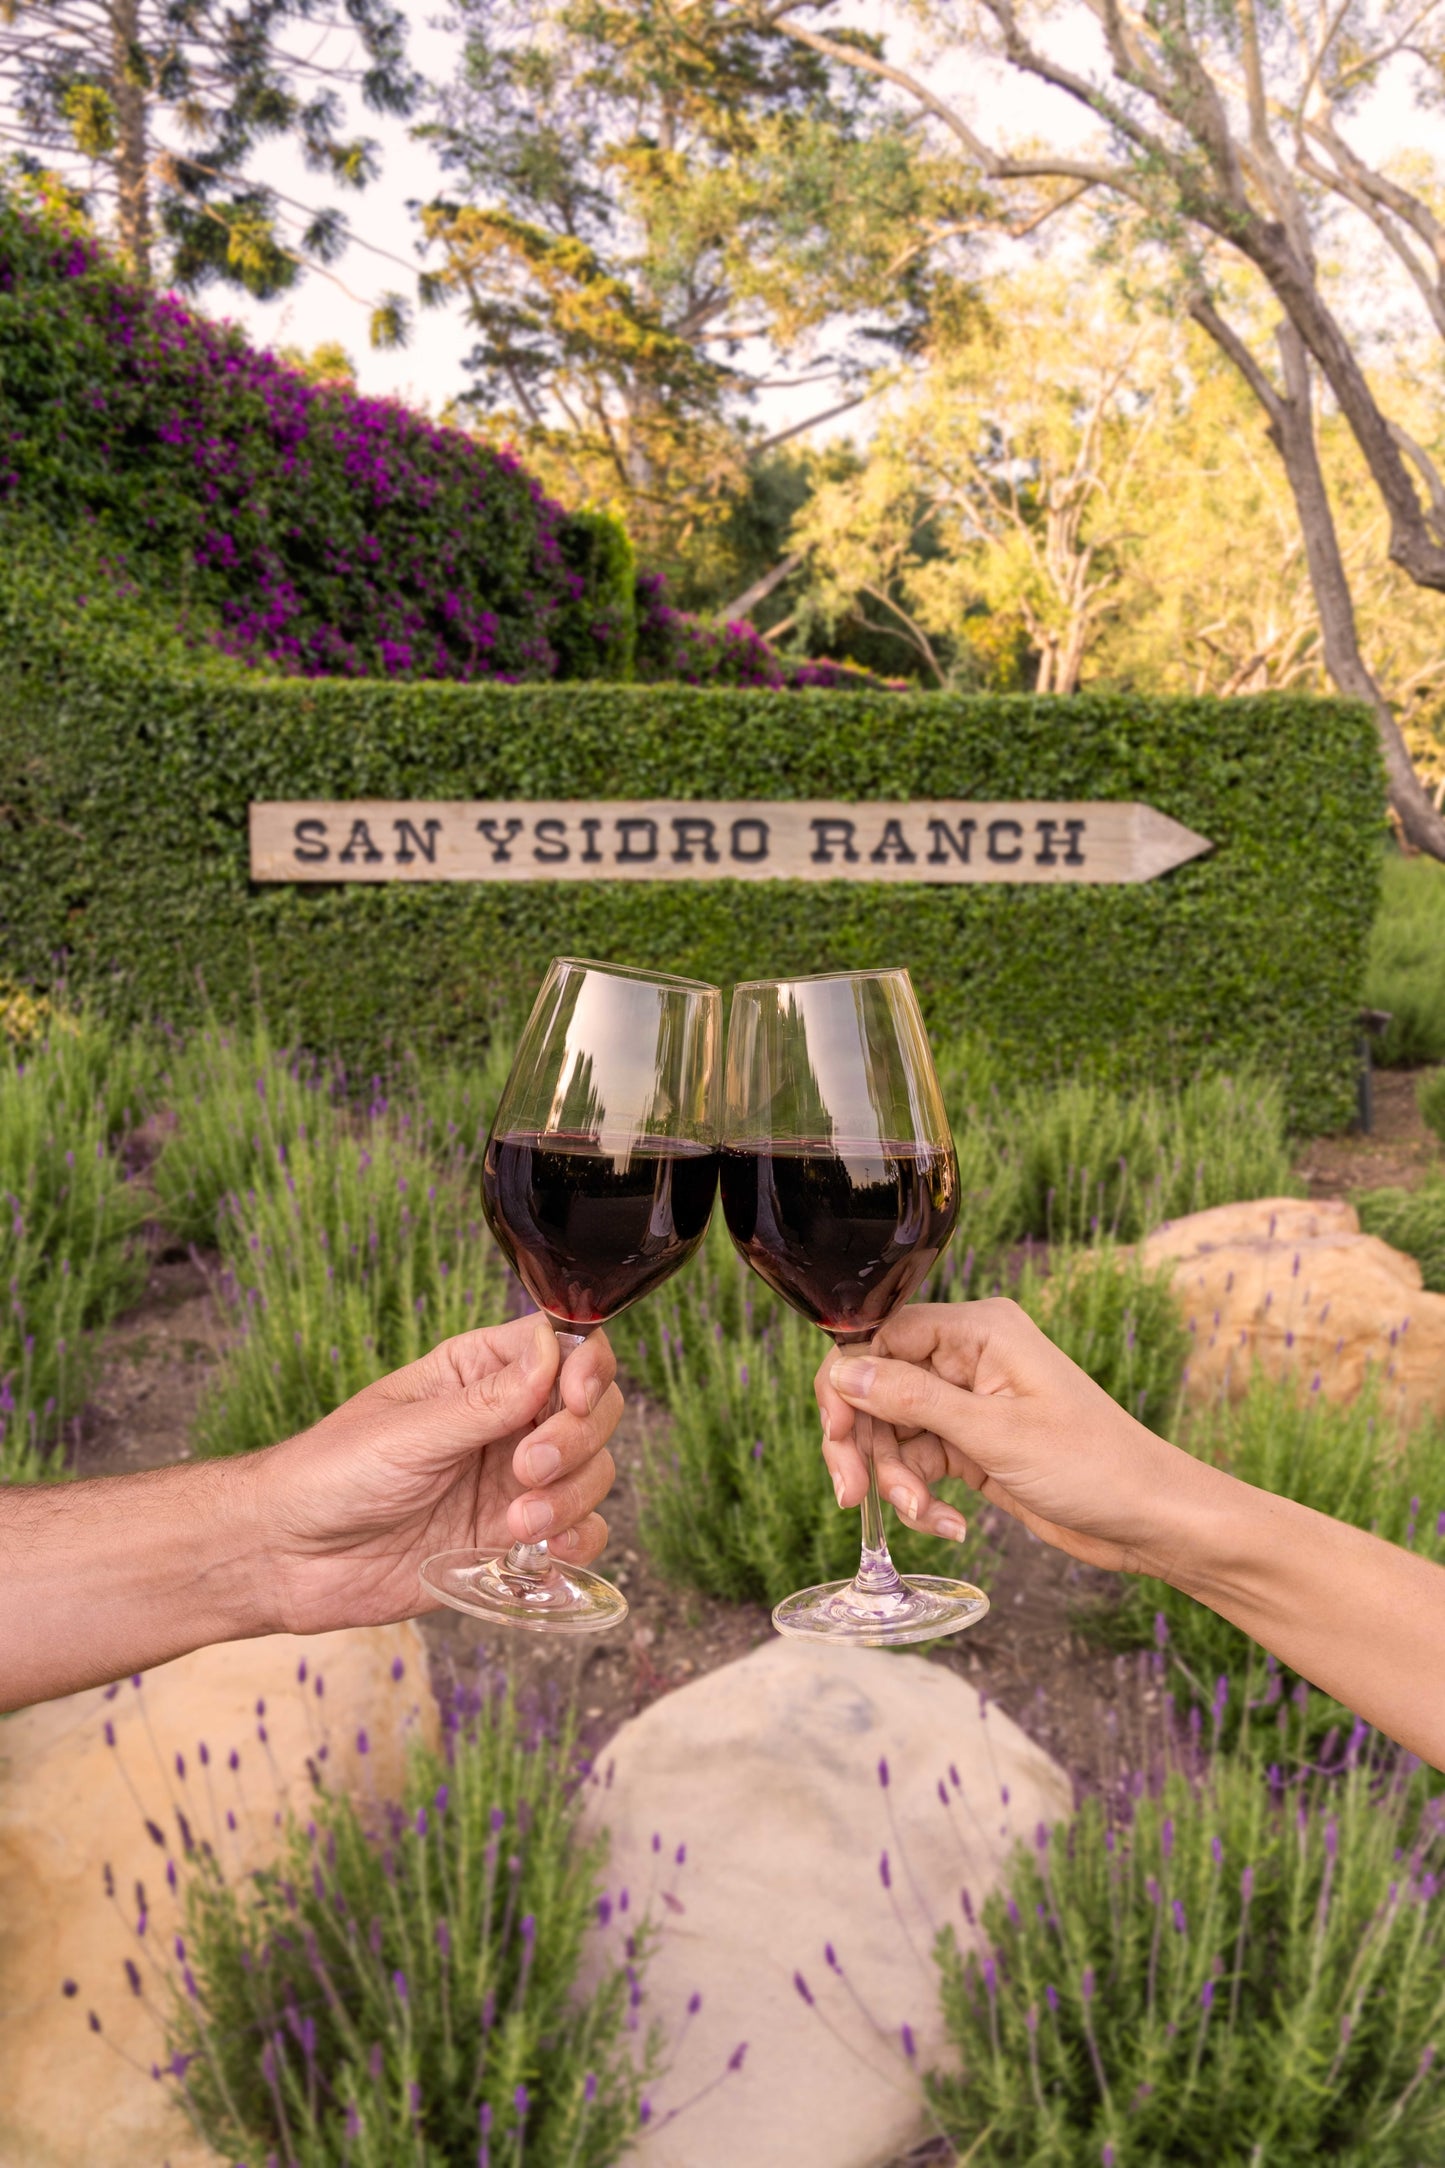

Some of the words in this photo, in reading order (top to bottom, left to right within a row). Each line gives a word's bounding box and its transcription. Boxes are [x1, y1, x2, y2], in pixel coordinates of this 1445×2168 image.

[293, 818, 442, 863] SAN
[477, 818, 770, 864] YSIDRO
[810, 818, 1086, 865] RANCH
